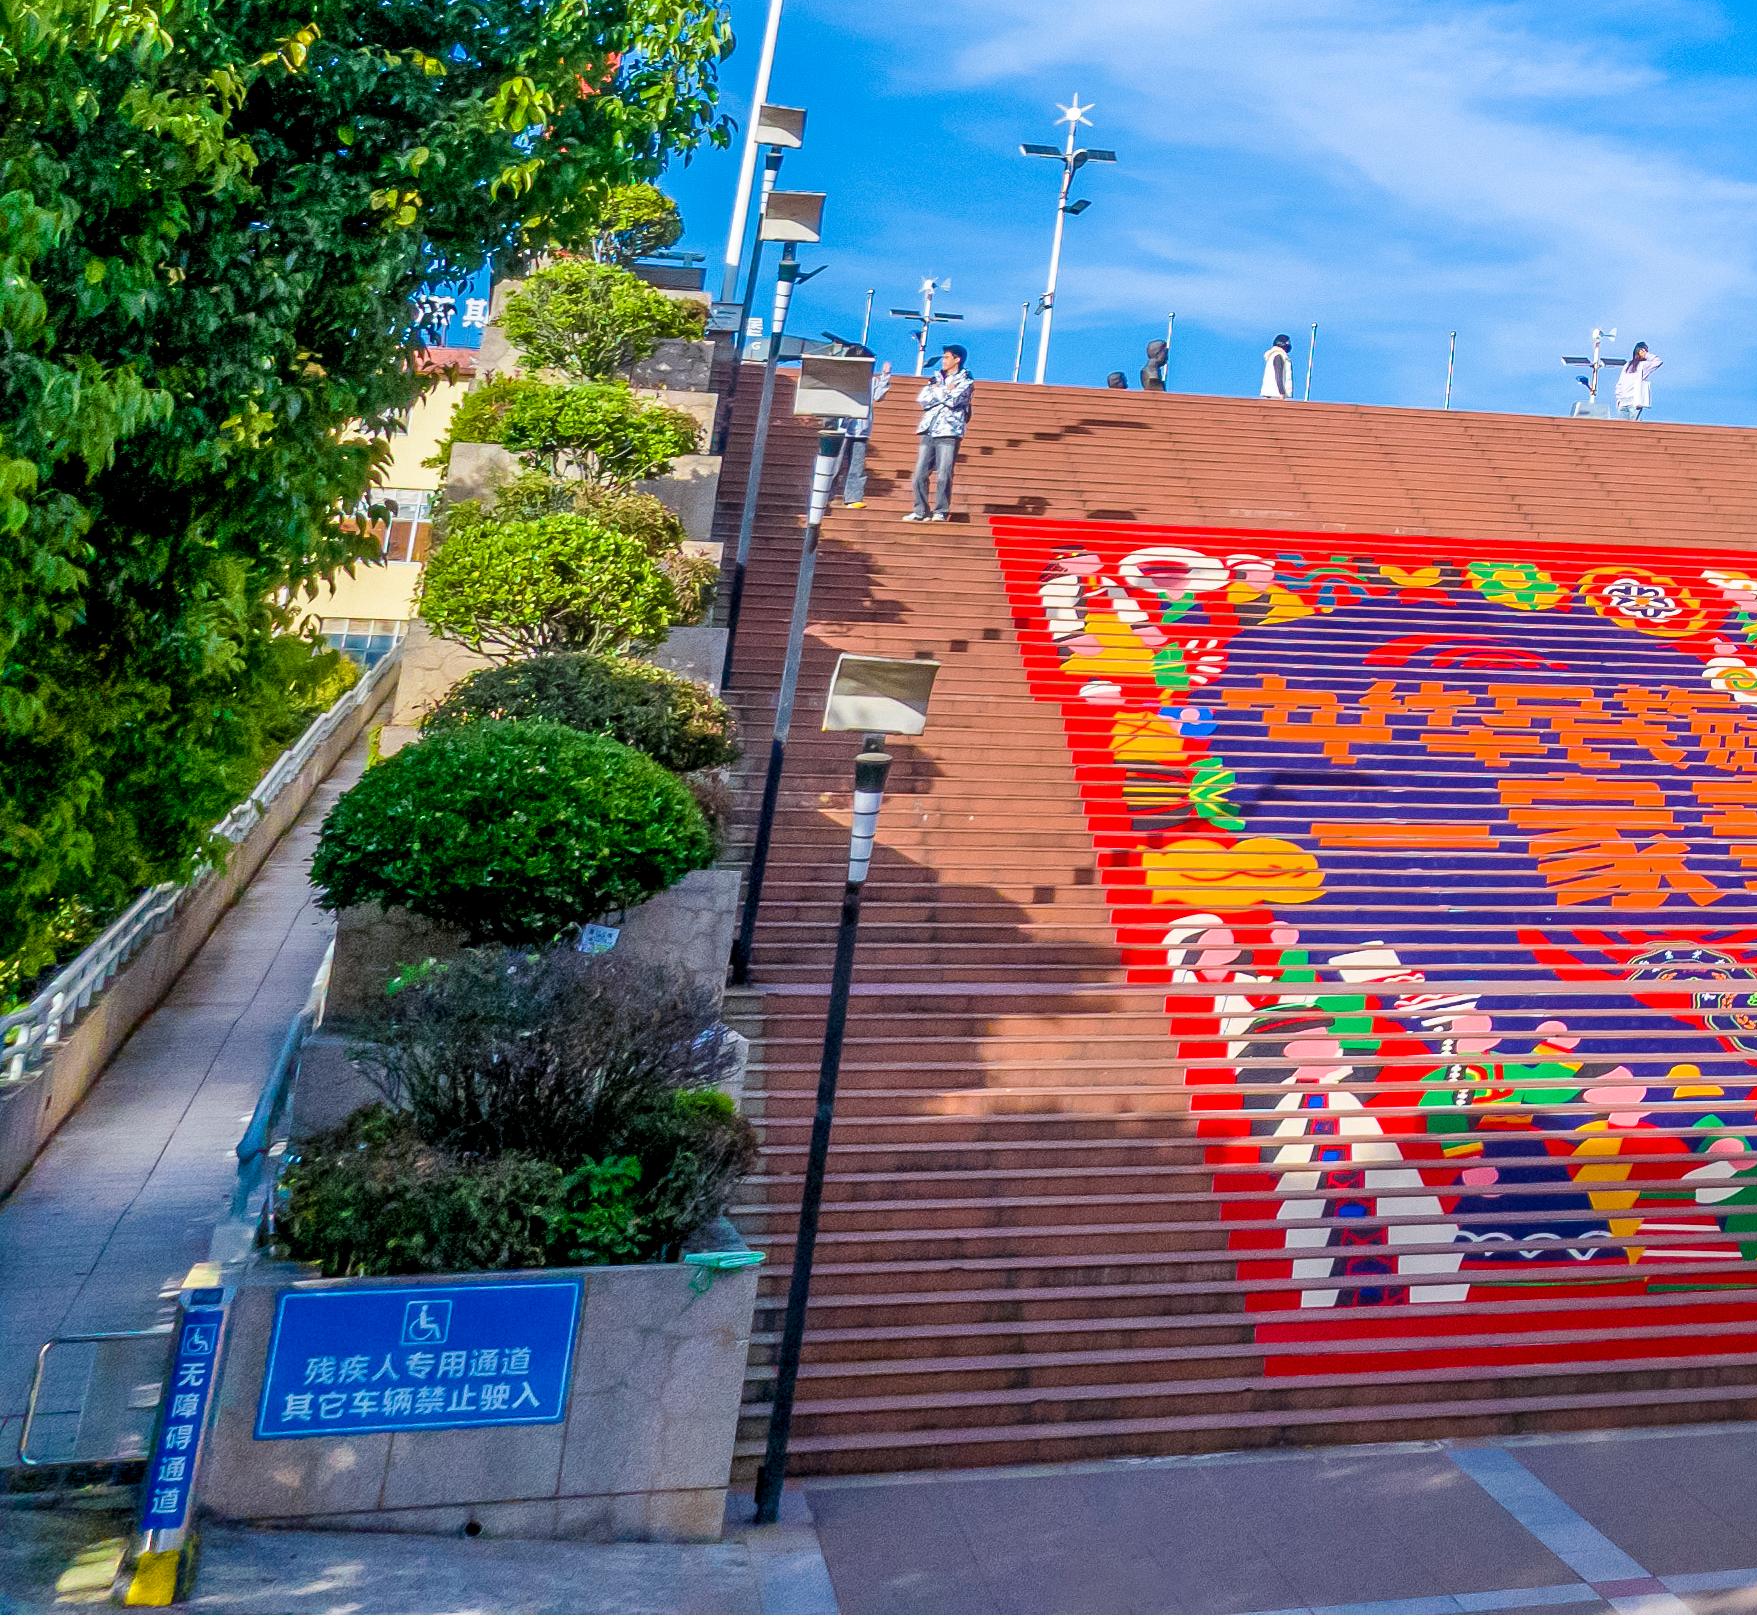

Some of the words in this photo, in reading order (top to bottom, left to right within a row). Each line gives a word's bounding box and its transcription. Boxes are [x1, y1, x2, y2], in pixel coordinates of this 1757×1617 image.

[303, 1346, 533, 1385] 残疾人专用通道
[281, 1380, 542, 1423] 其它车辆禁止驶入
[151, 1362, 206, 1514] 无障碍通道
